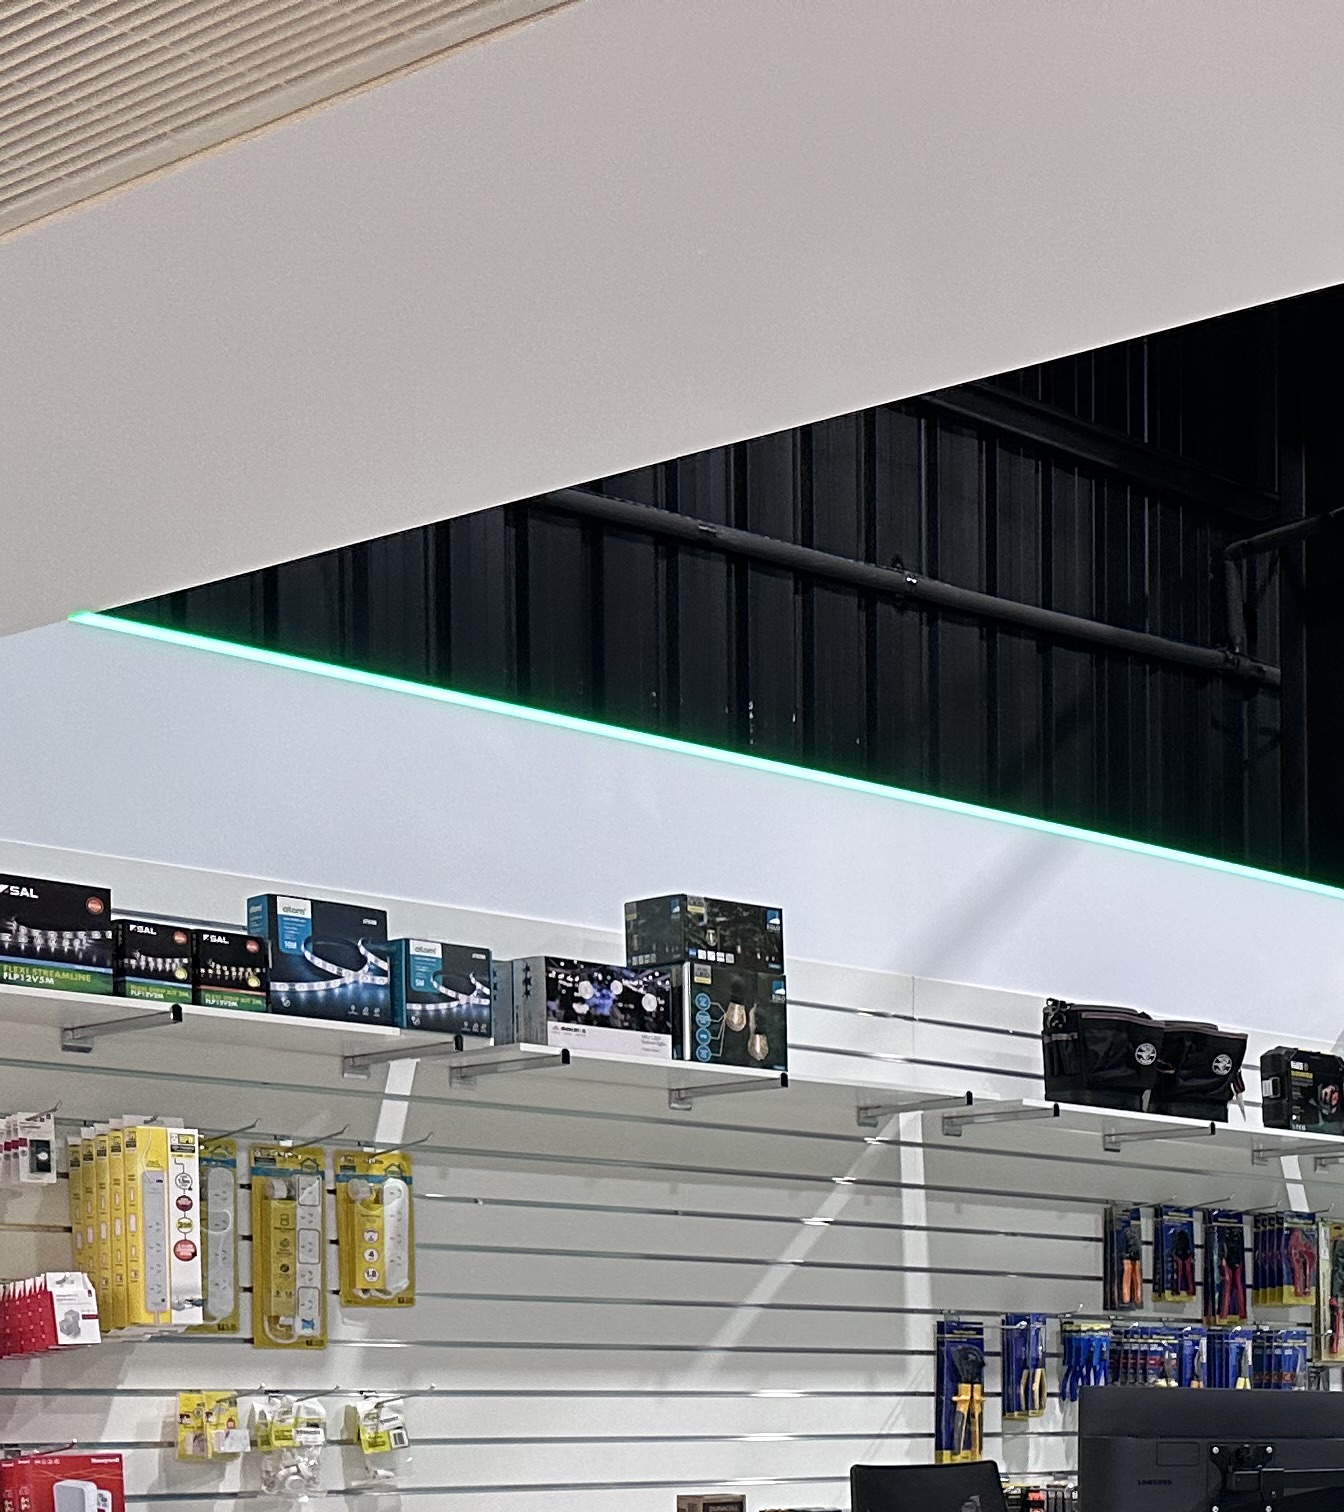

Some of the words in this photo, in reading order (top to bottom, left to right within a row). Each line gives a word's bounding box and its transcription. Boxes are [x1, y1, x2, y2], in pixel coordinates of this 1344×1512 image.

[9, 885, 39, 899] SAL
[137, 926, 157, 935] SAL
[210, 935, 229, 944] SAL
